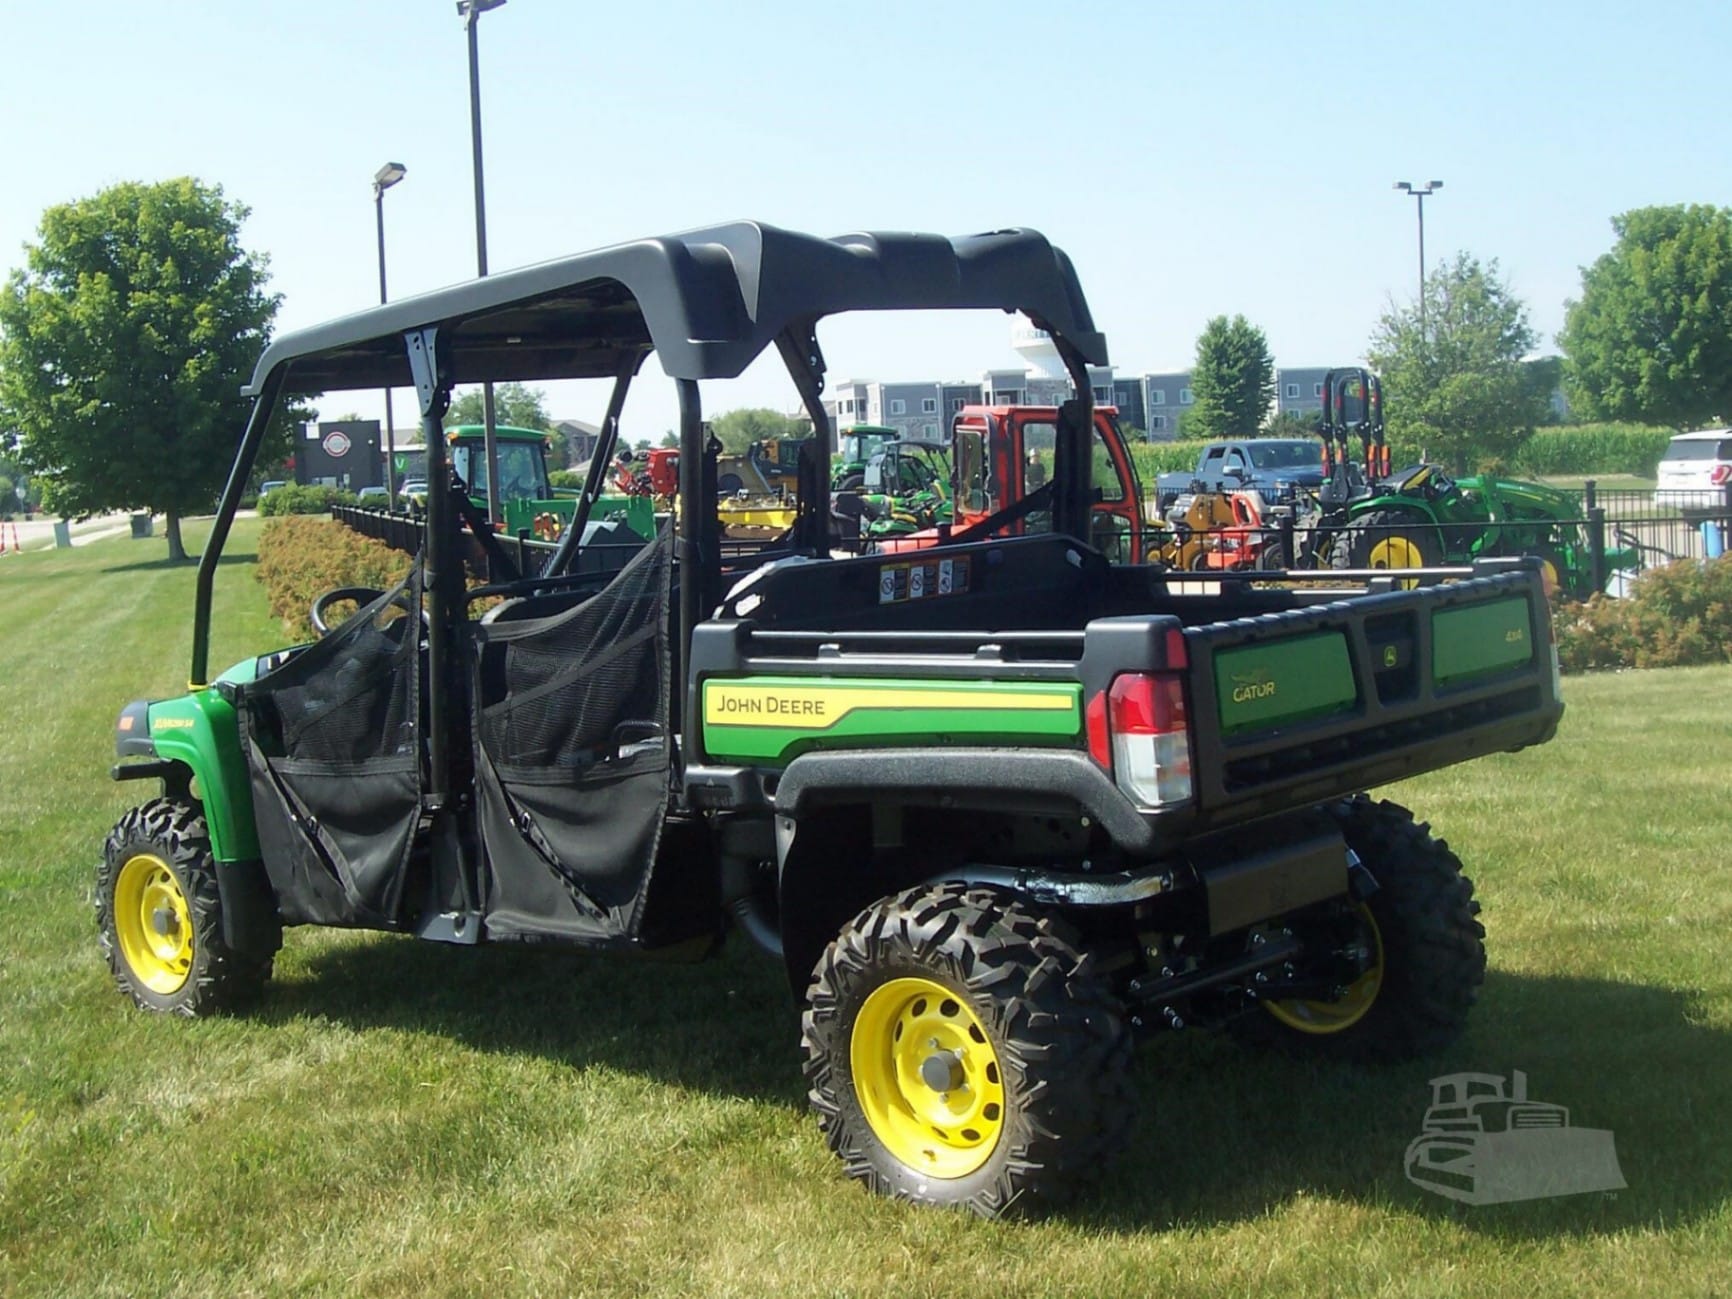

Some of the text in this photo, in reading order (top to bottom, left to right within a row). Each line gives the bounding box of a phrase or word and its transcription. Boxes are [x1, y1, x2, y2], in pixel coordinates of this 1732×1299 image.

[1232, 681, 1275, 702] GATOR
[717, 695, 825, 715] JOHN DEERE
